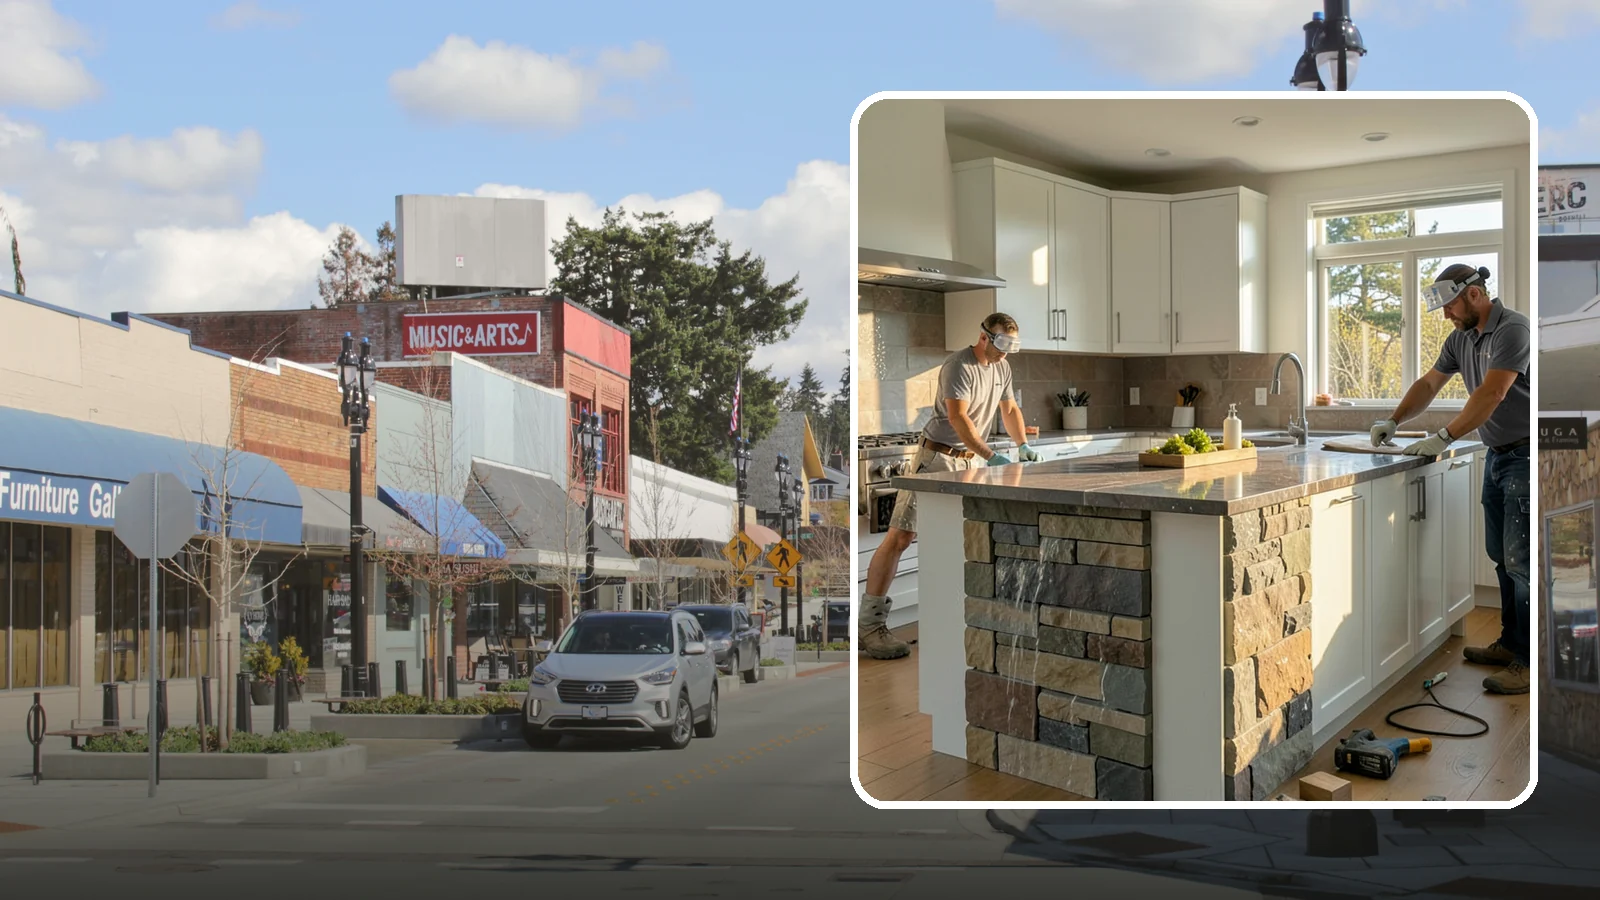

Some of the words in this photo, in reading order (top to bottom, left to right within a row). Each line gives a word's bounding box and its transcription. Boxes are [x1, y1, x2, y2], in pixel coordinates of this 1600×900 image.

[0, 471, 79, 515] Furniture
[90, 482, 121, 519] Gal
[453, 563, 479, 574] SUSHI
